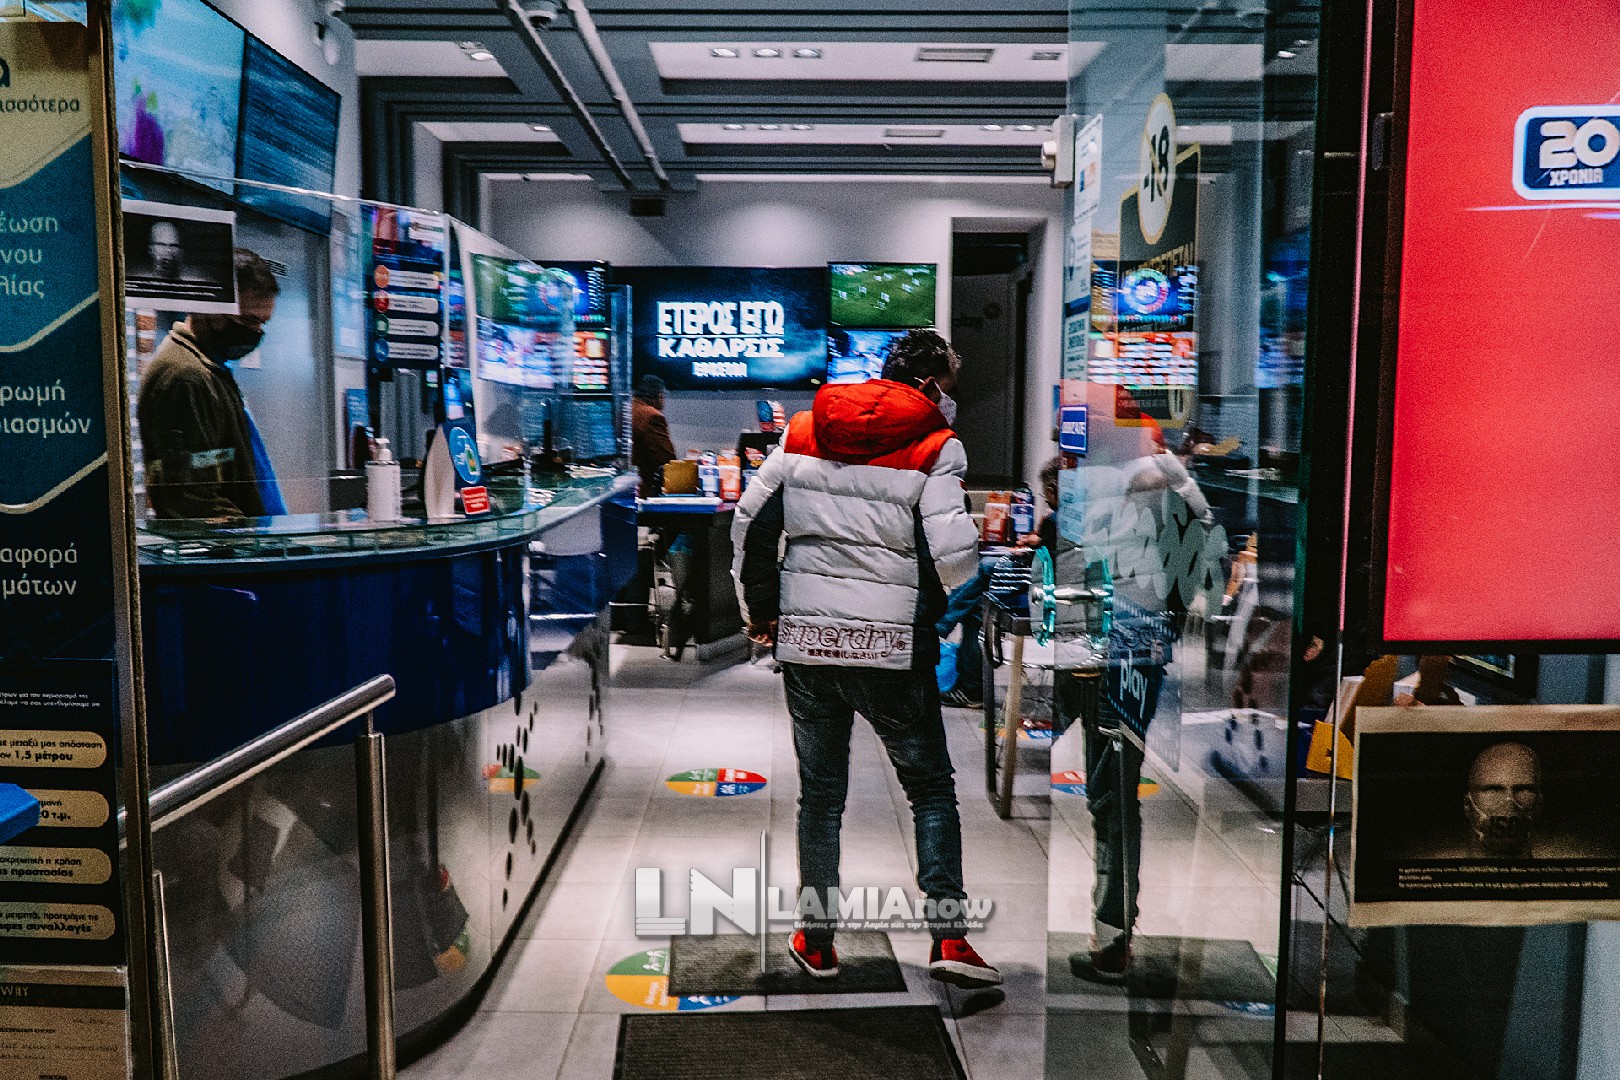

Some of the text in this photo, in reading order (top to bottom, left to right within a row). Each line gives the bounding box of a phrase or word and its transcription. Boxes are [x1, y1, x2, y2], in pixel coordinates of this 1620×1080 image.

[1539, 118, 1620, 169] 20
[0, 248, 42, 265] νου
[656, 301, 738, 335] ΕΤΕΡΟΣ
[657, 337, 785, 358] ΚΑΘΑΡΣΙΣ
[0, 379, 66, 407] ρωμή
[0, 411, 91, 439] ιασμών
[0, 541, 78, 569] αφορά
[2, 573, 77, 601] μάτων
[1120, 649, 1149, 720] play
[15, 750, 31, 760] 1,5
[35, 751, 73, 762] μέτρου
